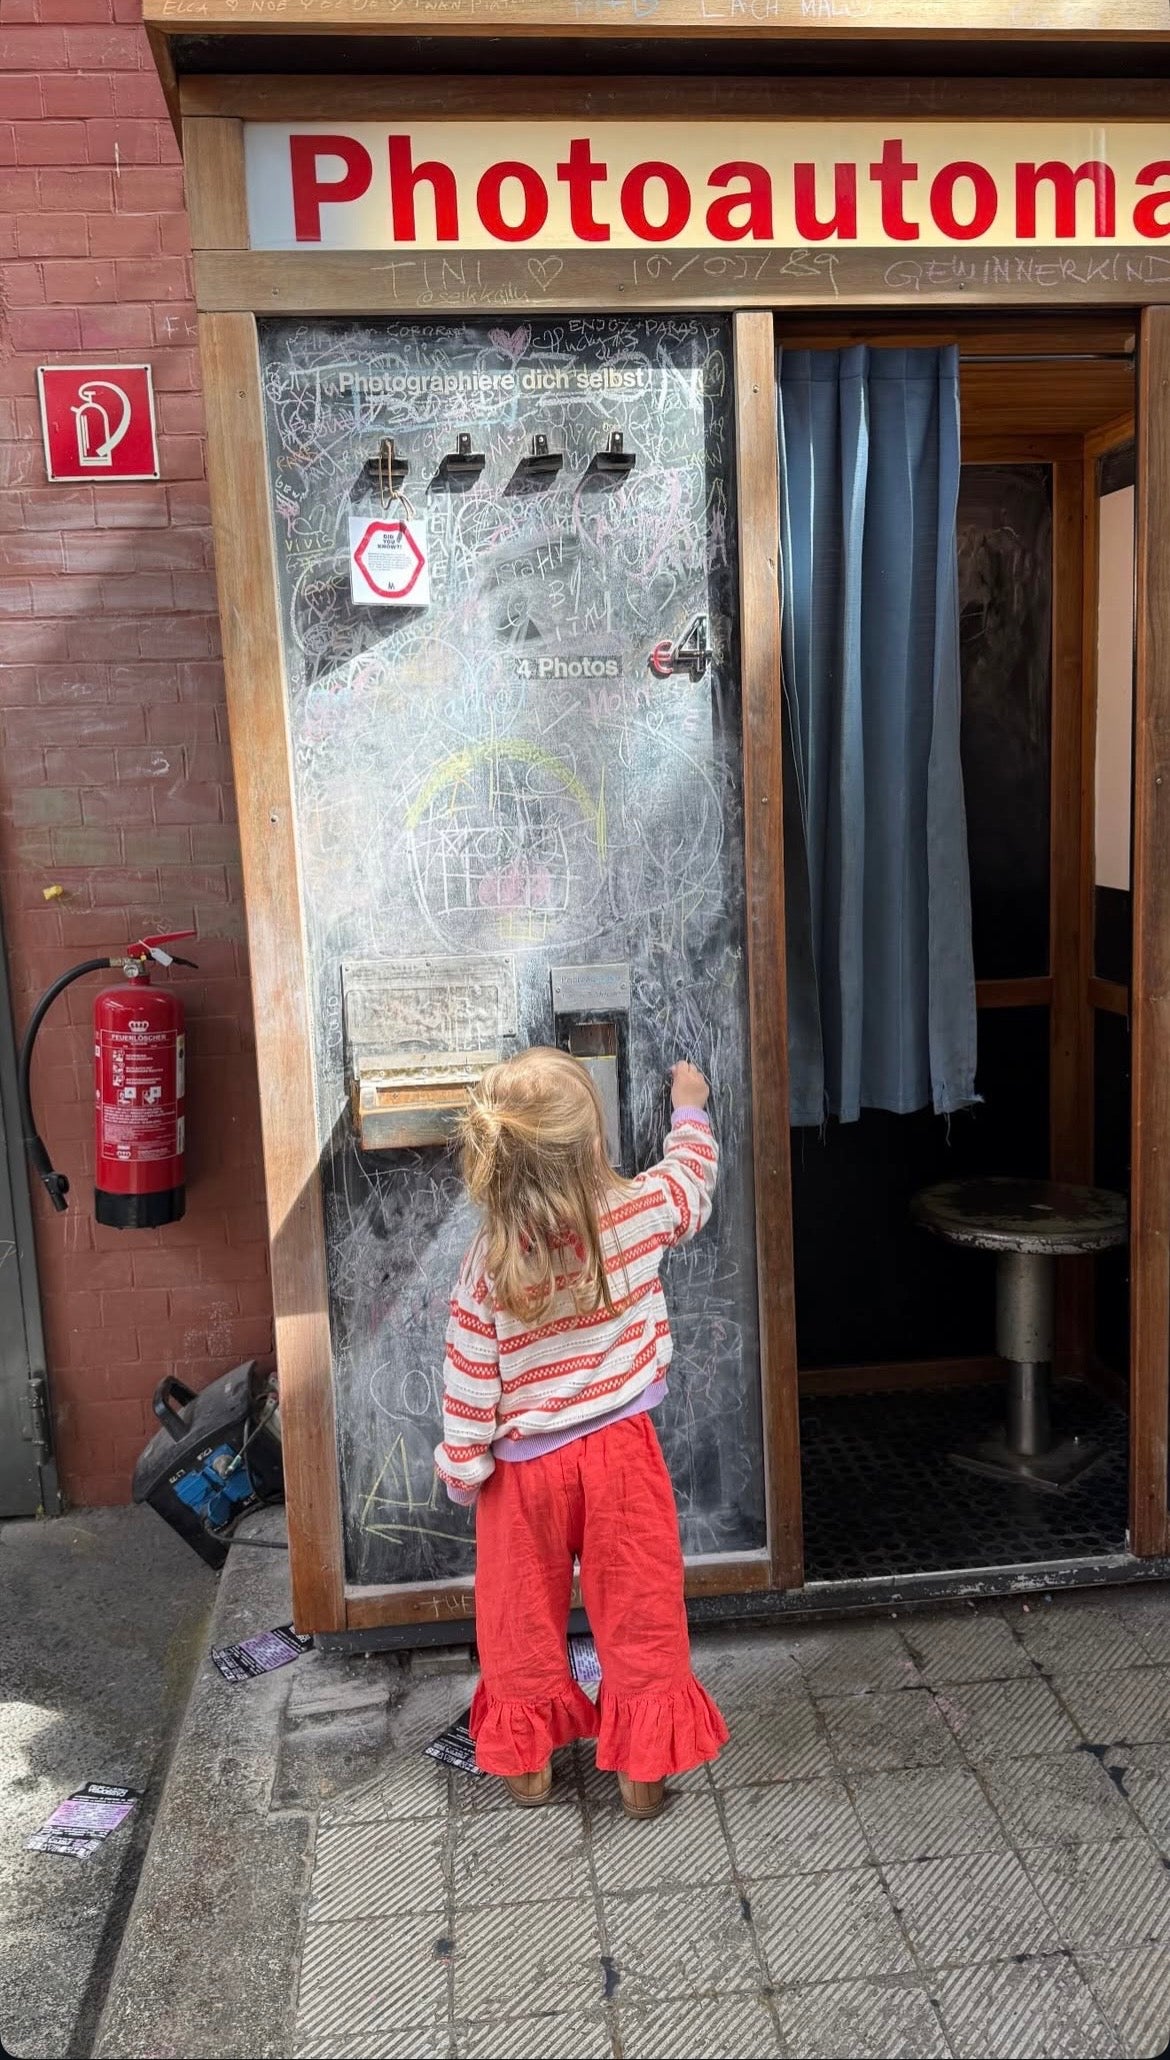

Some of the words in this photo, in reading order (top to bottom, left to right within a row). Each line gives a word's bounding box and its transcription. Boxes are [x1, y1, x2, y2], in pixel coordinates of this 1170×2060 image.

[370, 256, 482, 299] TINI
[339, 370, 515, 395] Photographiere
[522, 370, 570, 390] dich
[576, 367, 646, 388] selbst
[538, 657, 620, 678] Photos
